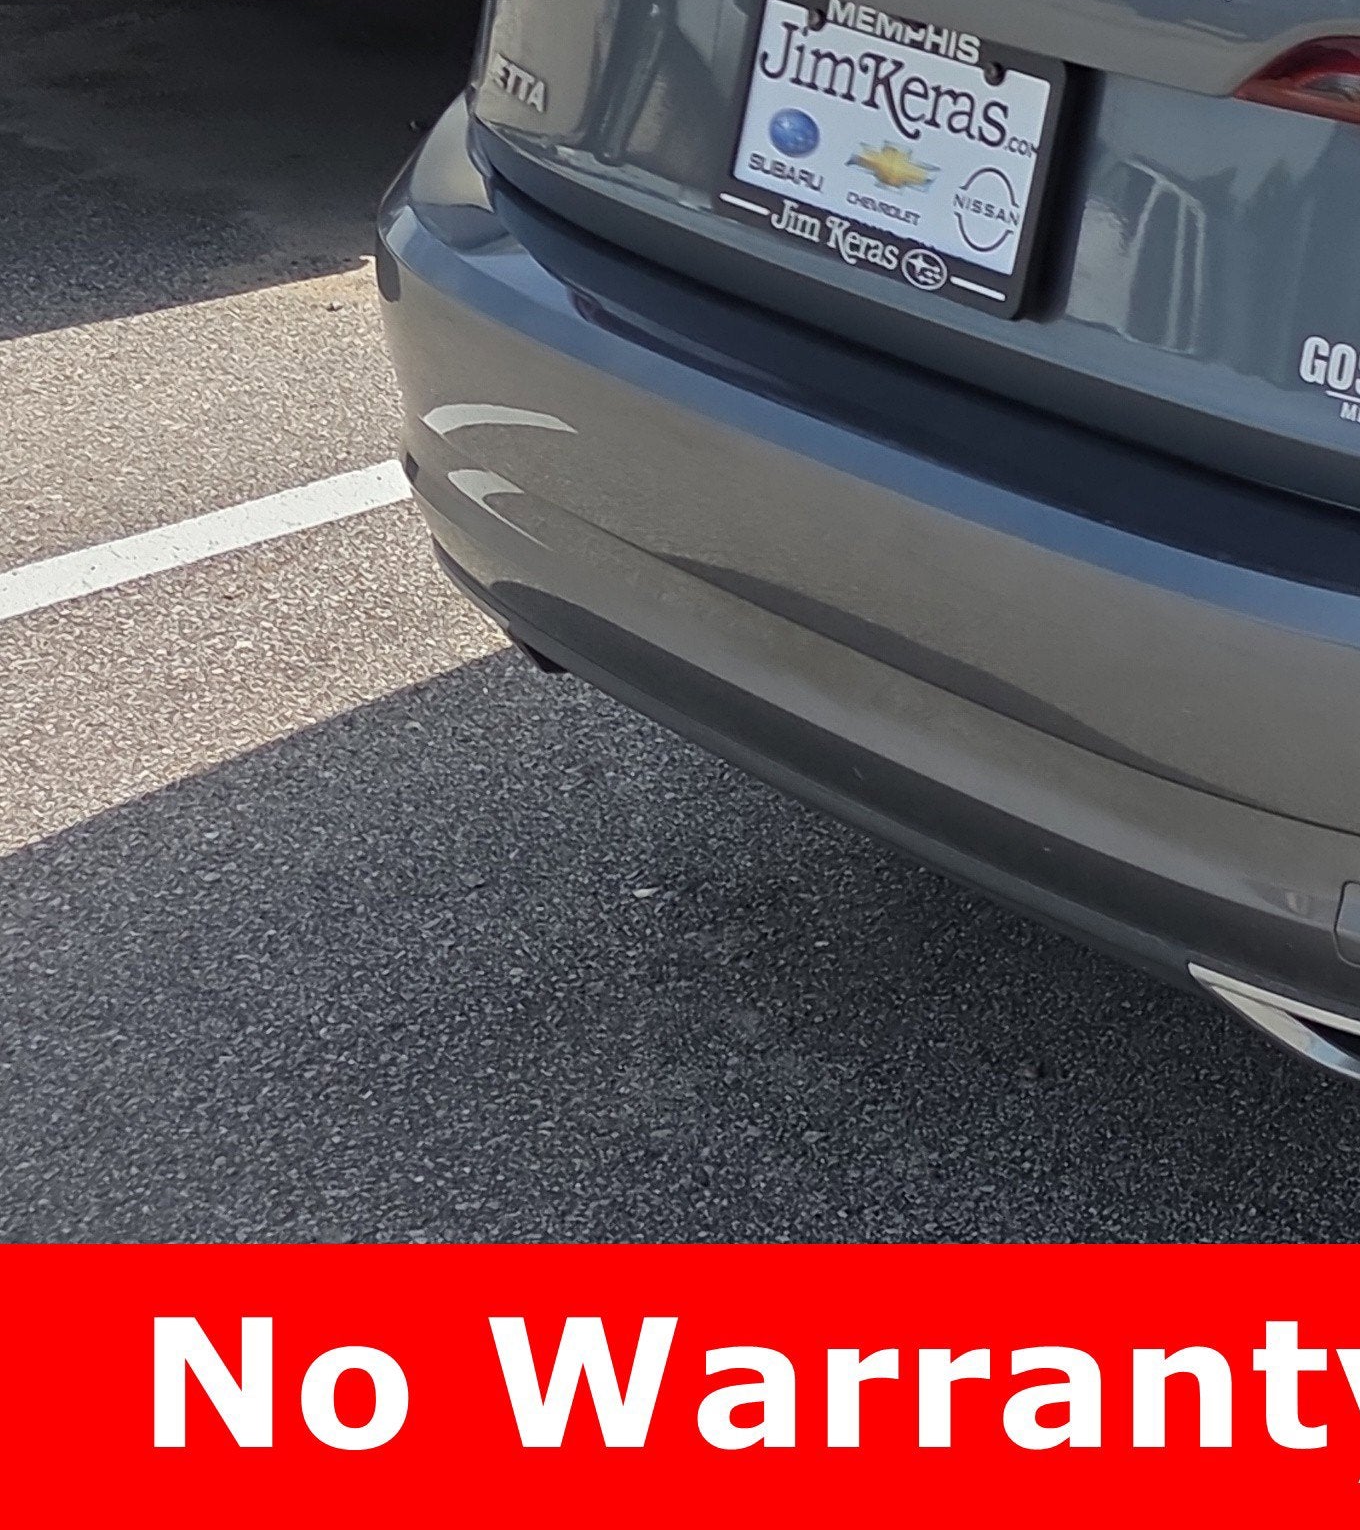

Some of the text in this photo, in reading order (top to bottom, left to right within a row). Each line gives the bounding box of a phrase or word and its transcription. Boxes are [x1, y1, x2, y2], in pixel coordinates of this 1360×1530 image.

[748, 152, 825, 194] SUBARU
[953, 193, 1020, 226] NISSAN
[771, 199, 900, 271] Jim Keras
